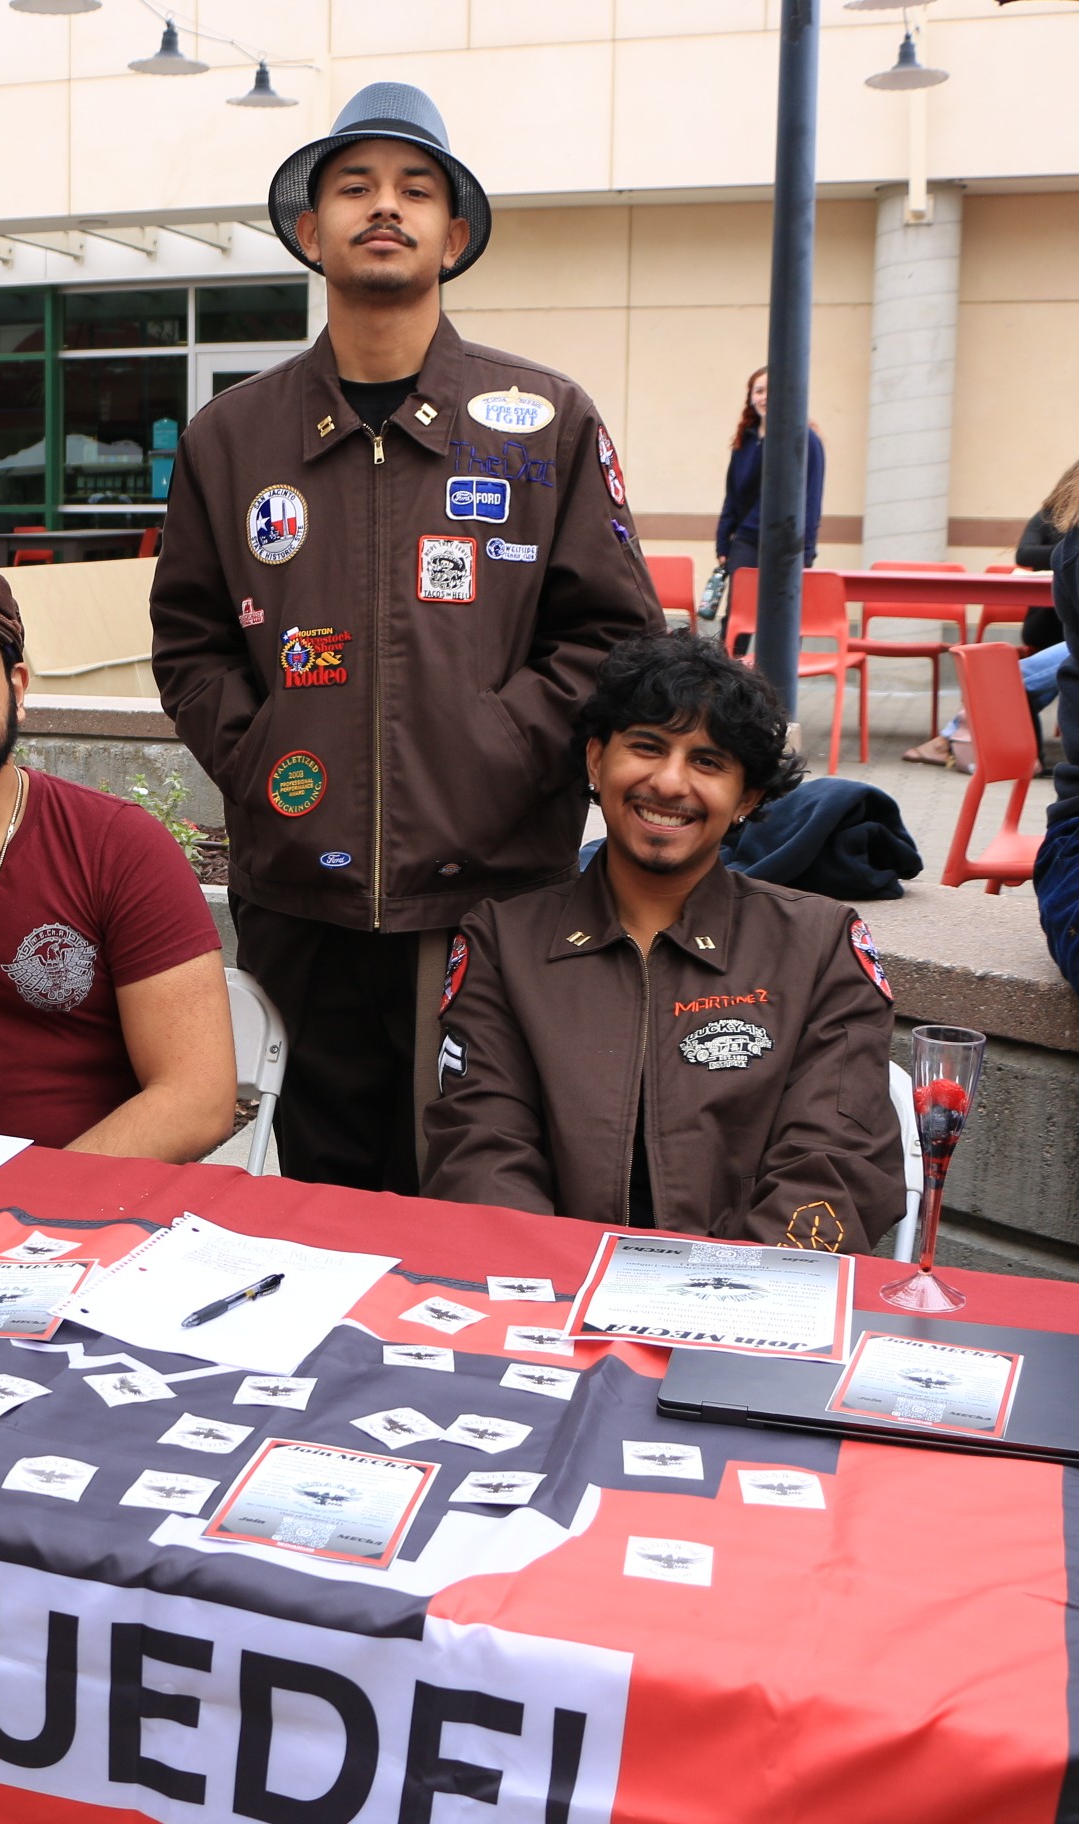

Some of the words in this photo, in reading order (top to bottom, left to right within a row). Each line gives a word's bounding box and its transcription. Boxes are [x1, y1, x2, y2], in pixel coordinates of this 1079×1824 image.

[485, 410, 537, 426] LIGHT
[253, 495, 266, 510] SAN
[267, 489, 296, 501] JACINTO
[476, 492, 501, 505] FORD
[251, 536, 263, 555] STATE
[265, 544, 296, 560] HISTORIC
[294, 525, 304, 542] SITE
[424, 590, 445, 599] TACOS
[452, 591, 469, 599] HELL
[295, 627, 333, 638] HOUSTON
[284, 665, 348, 688] Rodeo
[273, 755, 319, 779] PALLETIZED
[280, 778, 314, 787] PROFESSIONAL
[280, 783, 314, 792] PERFORMANCE
[272, 790, 311, 813] TRUCKING
[310, 781, 322, 801] INC.
[326, 854, 345, 864] Ford
[606, 1323, 731, 1345] MEChA
[883, 1336, 924, 1348] Join
[735, 1334, 808, 1351] Join
[288, 1445, 332, 1457] Join
[338, 1453, 413, 1471] MEChA
[238, 1516, 266, 1524] Join
